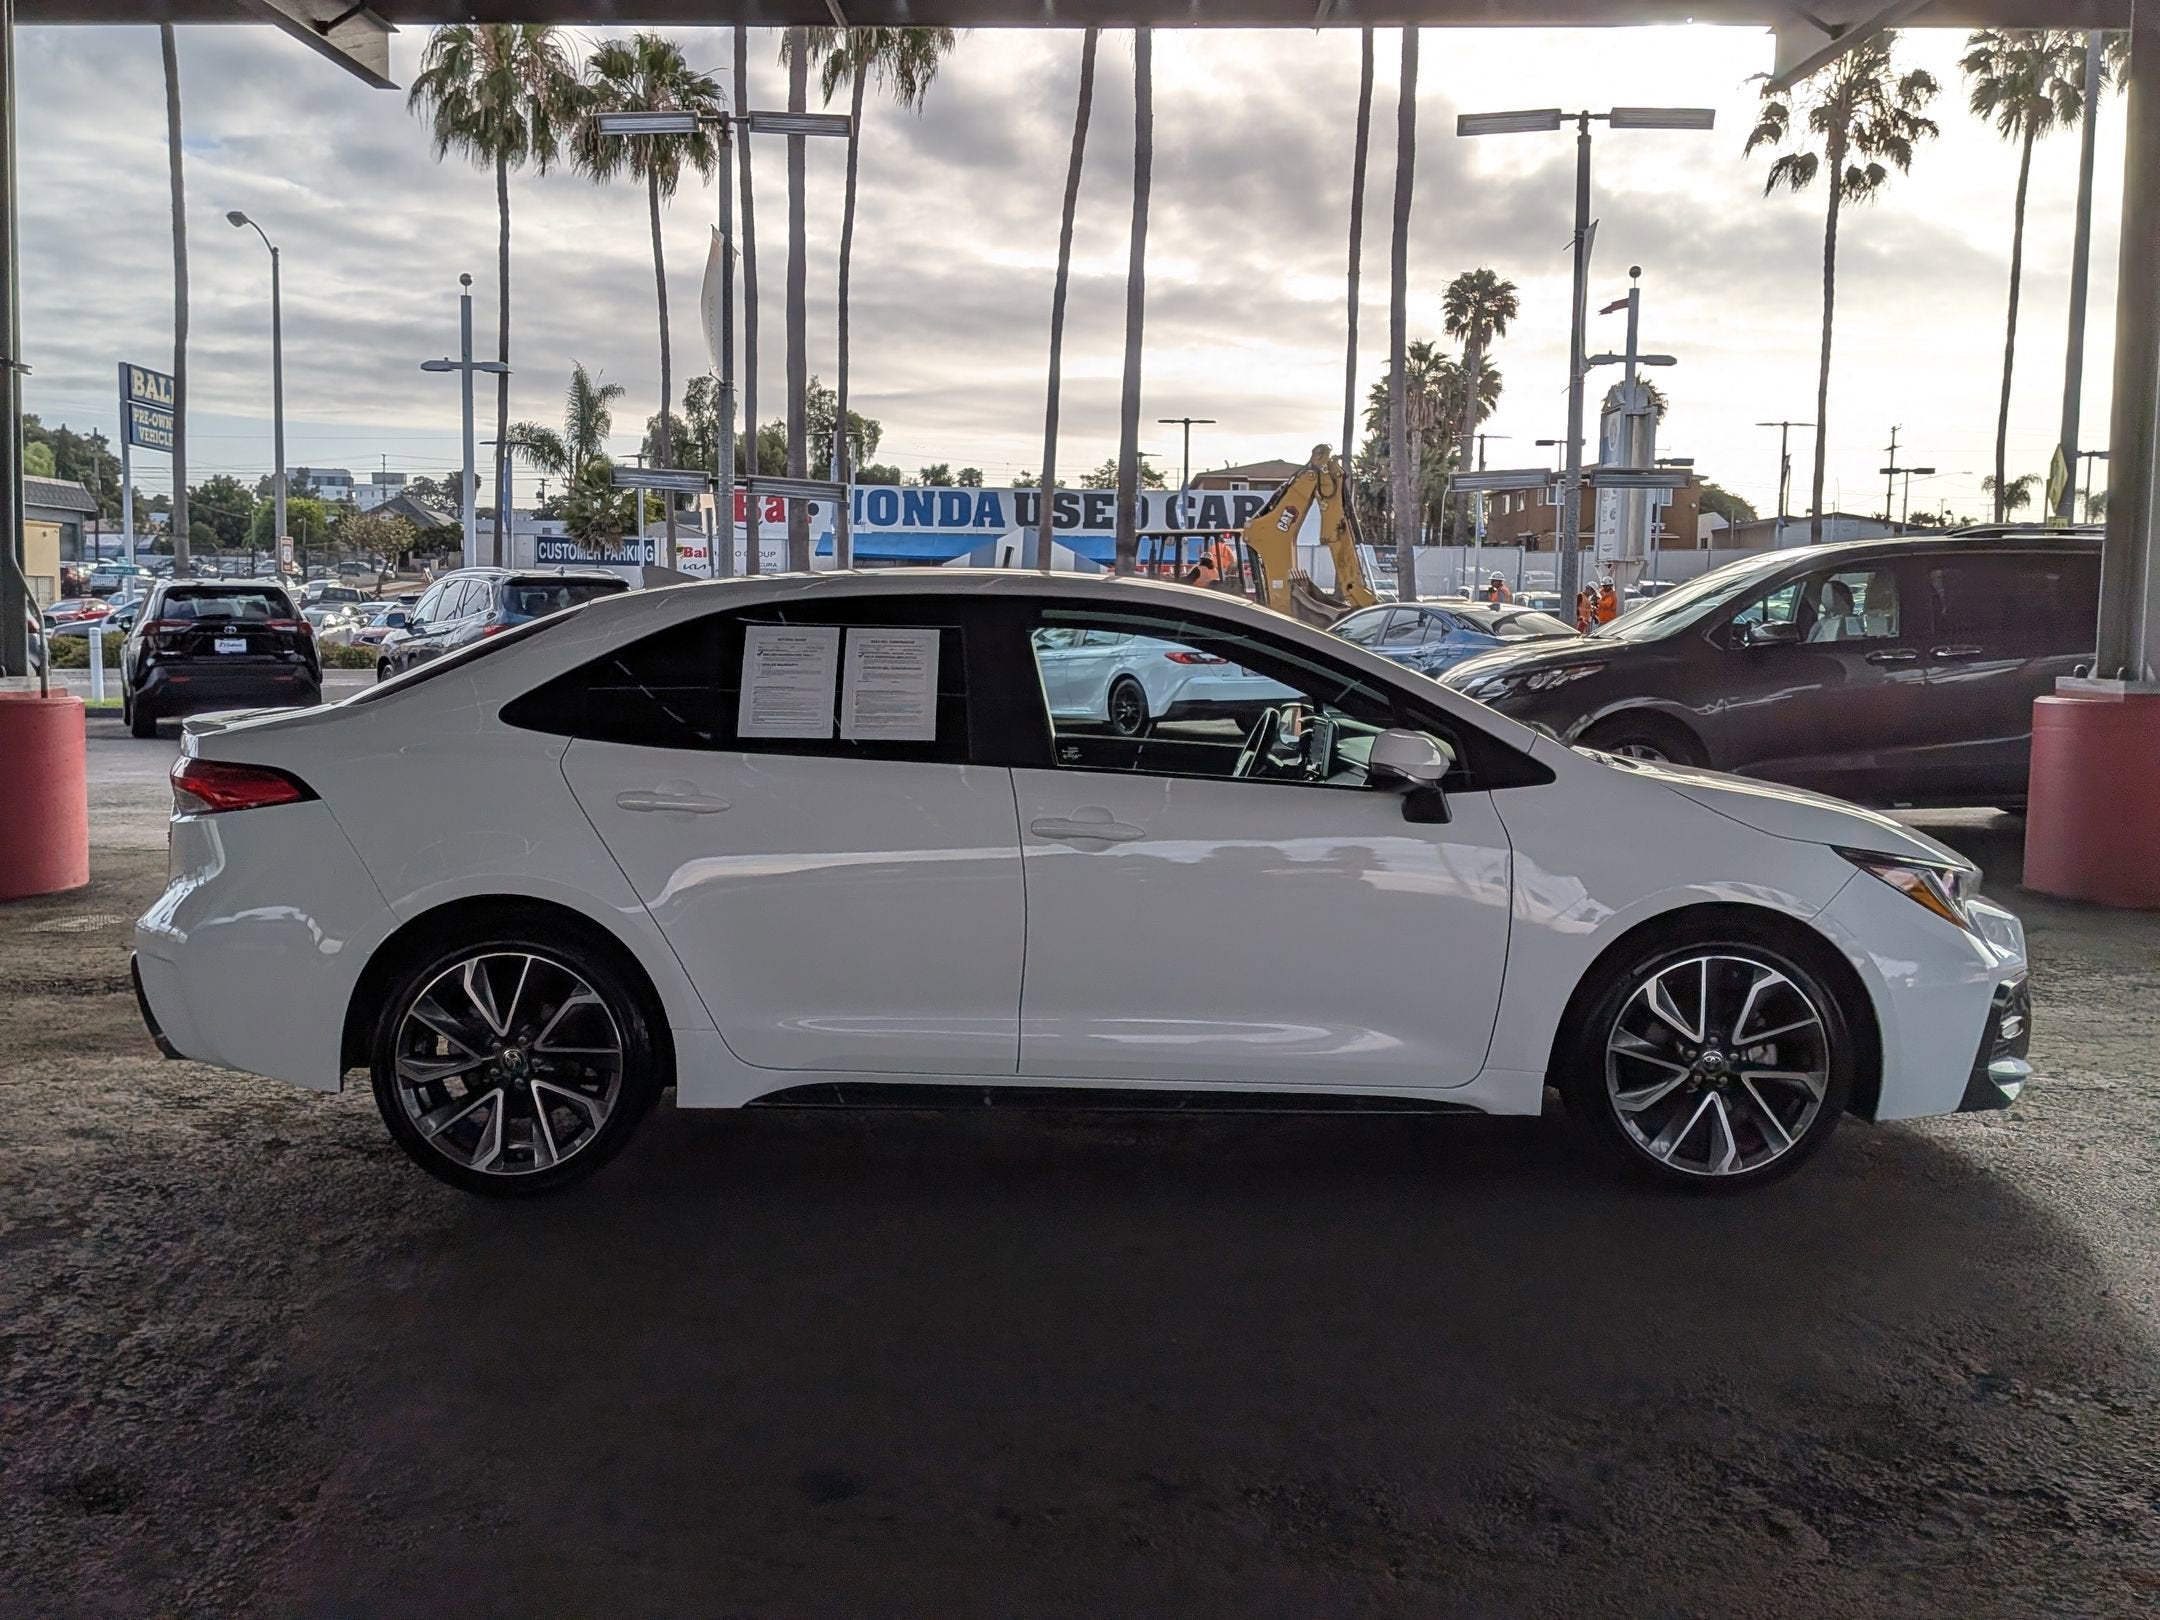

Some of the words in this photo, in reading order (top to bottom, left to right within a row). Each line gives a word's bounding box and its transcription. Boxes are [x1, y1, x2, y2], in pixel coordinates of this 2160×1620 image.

[131, 368, 174, 405] BAL
[132, 407, 174, 430] PRE-OWN
[138, 425, 173, 447] VEHICLE
[1166, 494, 1265, 530] CAR
[1277, 509, 1295, 532] CAT
[682, 547, 708, 559] Bal
